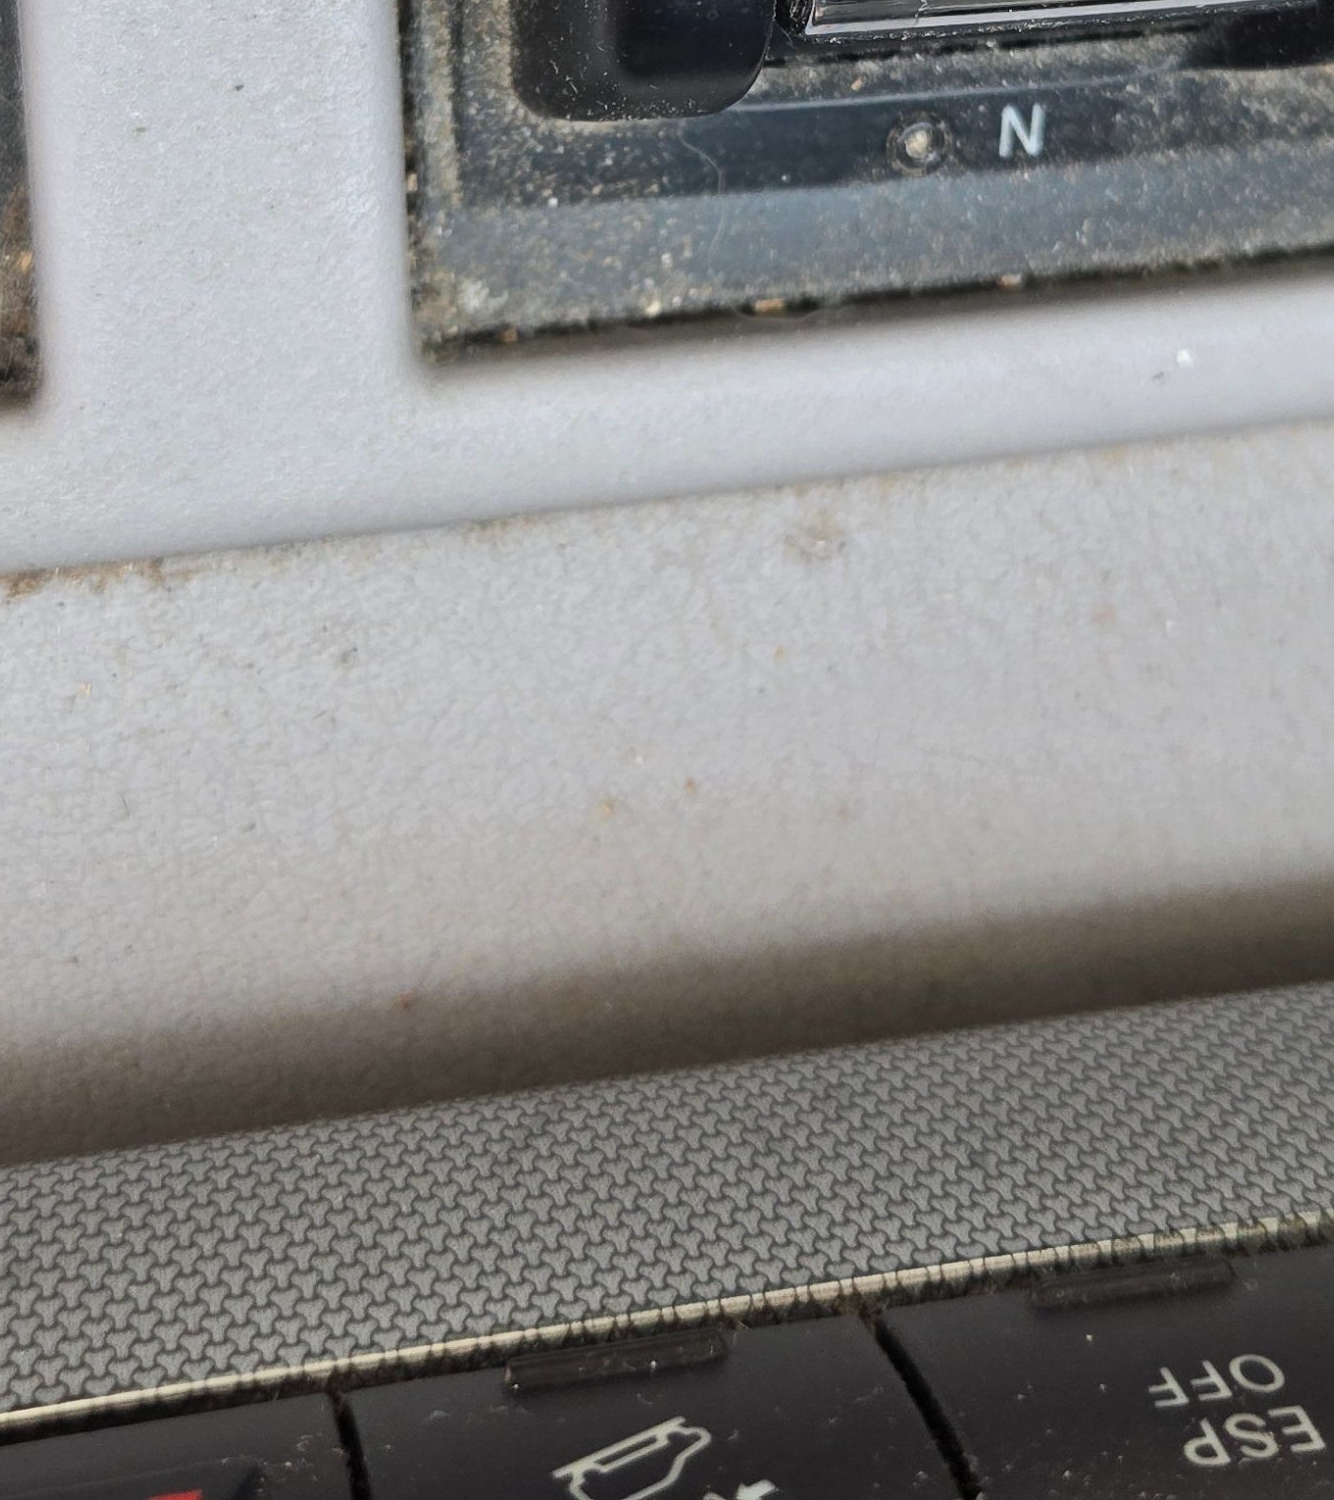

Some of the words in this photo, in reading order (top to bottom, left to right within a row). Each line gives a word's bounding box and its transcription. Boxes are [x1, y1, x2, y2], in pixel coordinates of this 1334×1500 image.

[998, 103, 1045, 158] N
[1148, 1354, 1286, 1408] OFF
[1183, 1404, 1326, 1468] ESP
